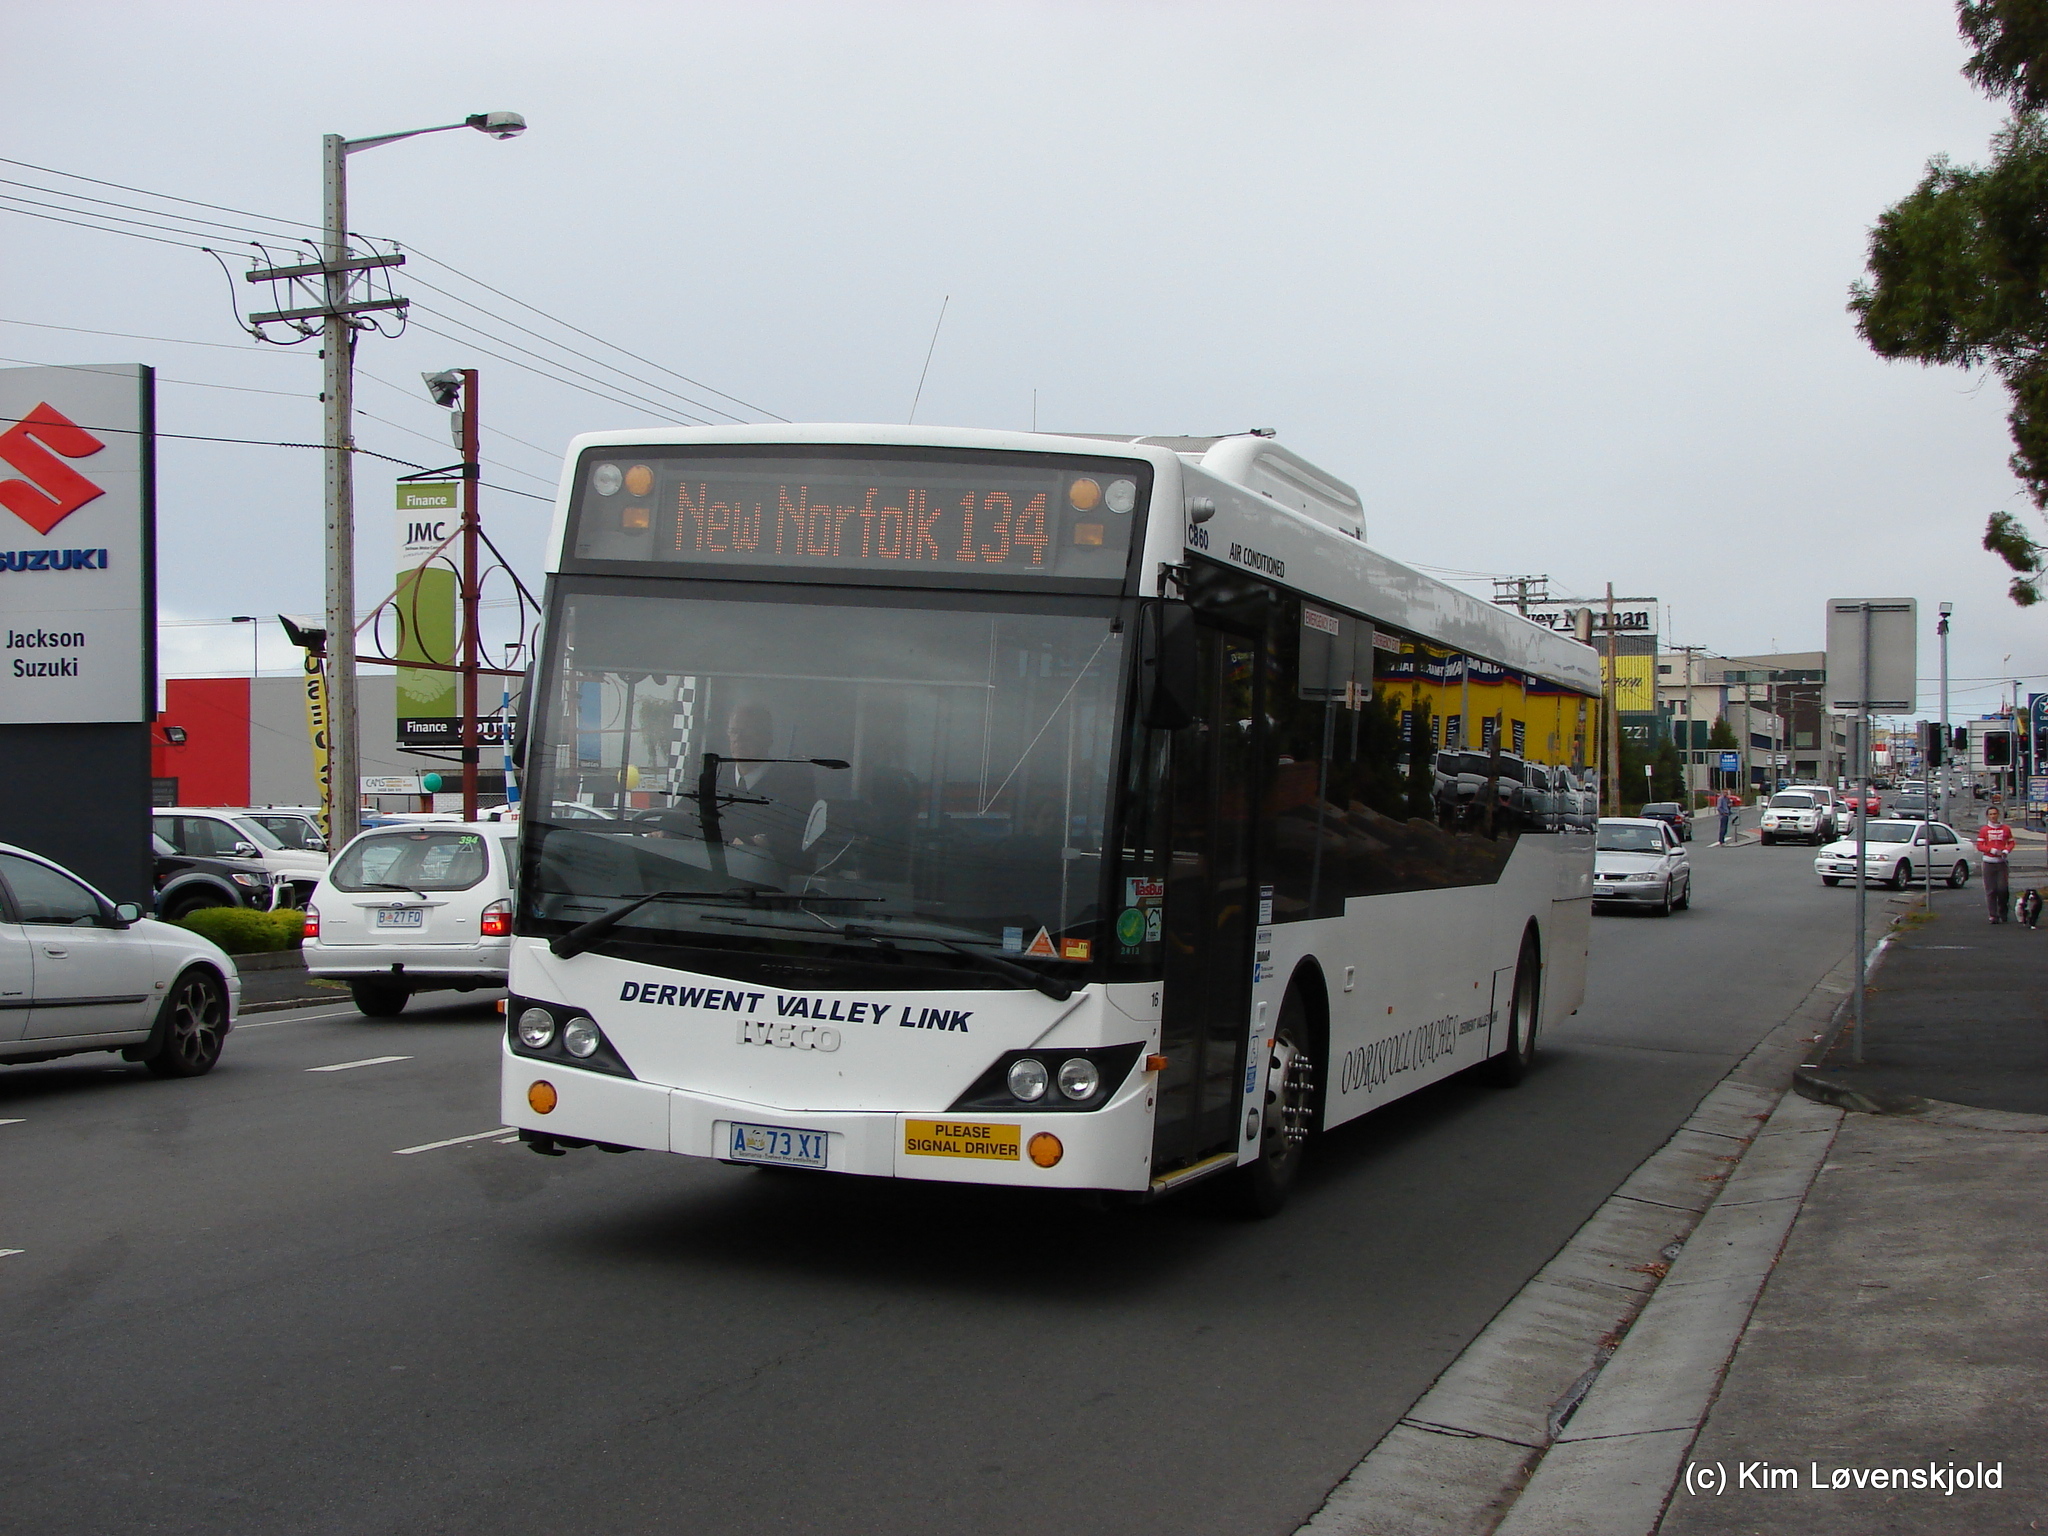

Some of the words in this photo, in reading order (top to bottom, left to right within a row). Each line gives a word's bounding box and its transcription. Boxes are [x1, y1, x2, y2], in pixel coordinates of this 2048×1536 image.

[406, 495, 447, 506] Finance
[406, 521, 446, 544] JMC
[676, 482, 761, 552] New
[776, 485, 941, 560] Norfolk
[956, 490, 1049, 564] 134
[1229, 542, 1242, 562] AIR
[1243, 548, 1285, 578] CONDITIONED
[1526, 613, 1559, 629] vey
[1564, 609, 1649, 628] Nman
[6, 629, 85, 649] Jackson
[13, 657, 79, 677] Suzuki
[406, 721, 448, 733] Finance
[458, 835, 479, 845] 394
[379, 912, 386, 923] B
[393, 911, 406, 923] 27
[619, 981, 765, 1013] DERWENT
[777, 995, 892, 1024] VALLEY
[899, 1006, 974, 1032] LINK
[736, 1019, 841, 1052] IVECO
[1413, 1014, 1459, 1071] COACHES
[935, 1124, 991, 1139] PLEASE
[734, 1127, 746, 1151] A
[766, 1131, 791, 1156] 73
[798, 1134, 822, 1158] XI
[907, 1138, 956, 1153] SIGNAL
[957, 1141, 1018, 1156] DRIVER
